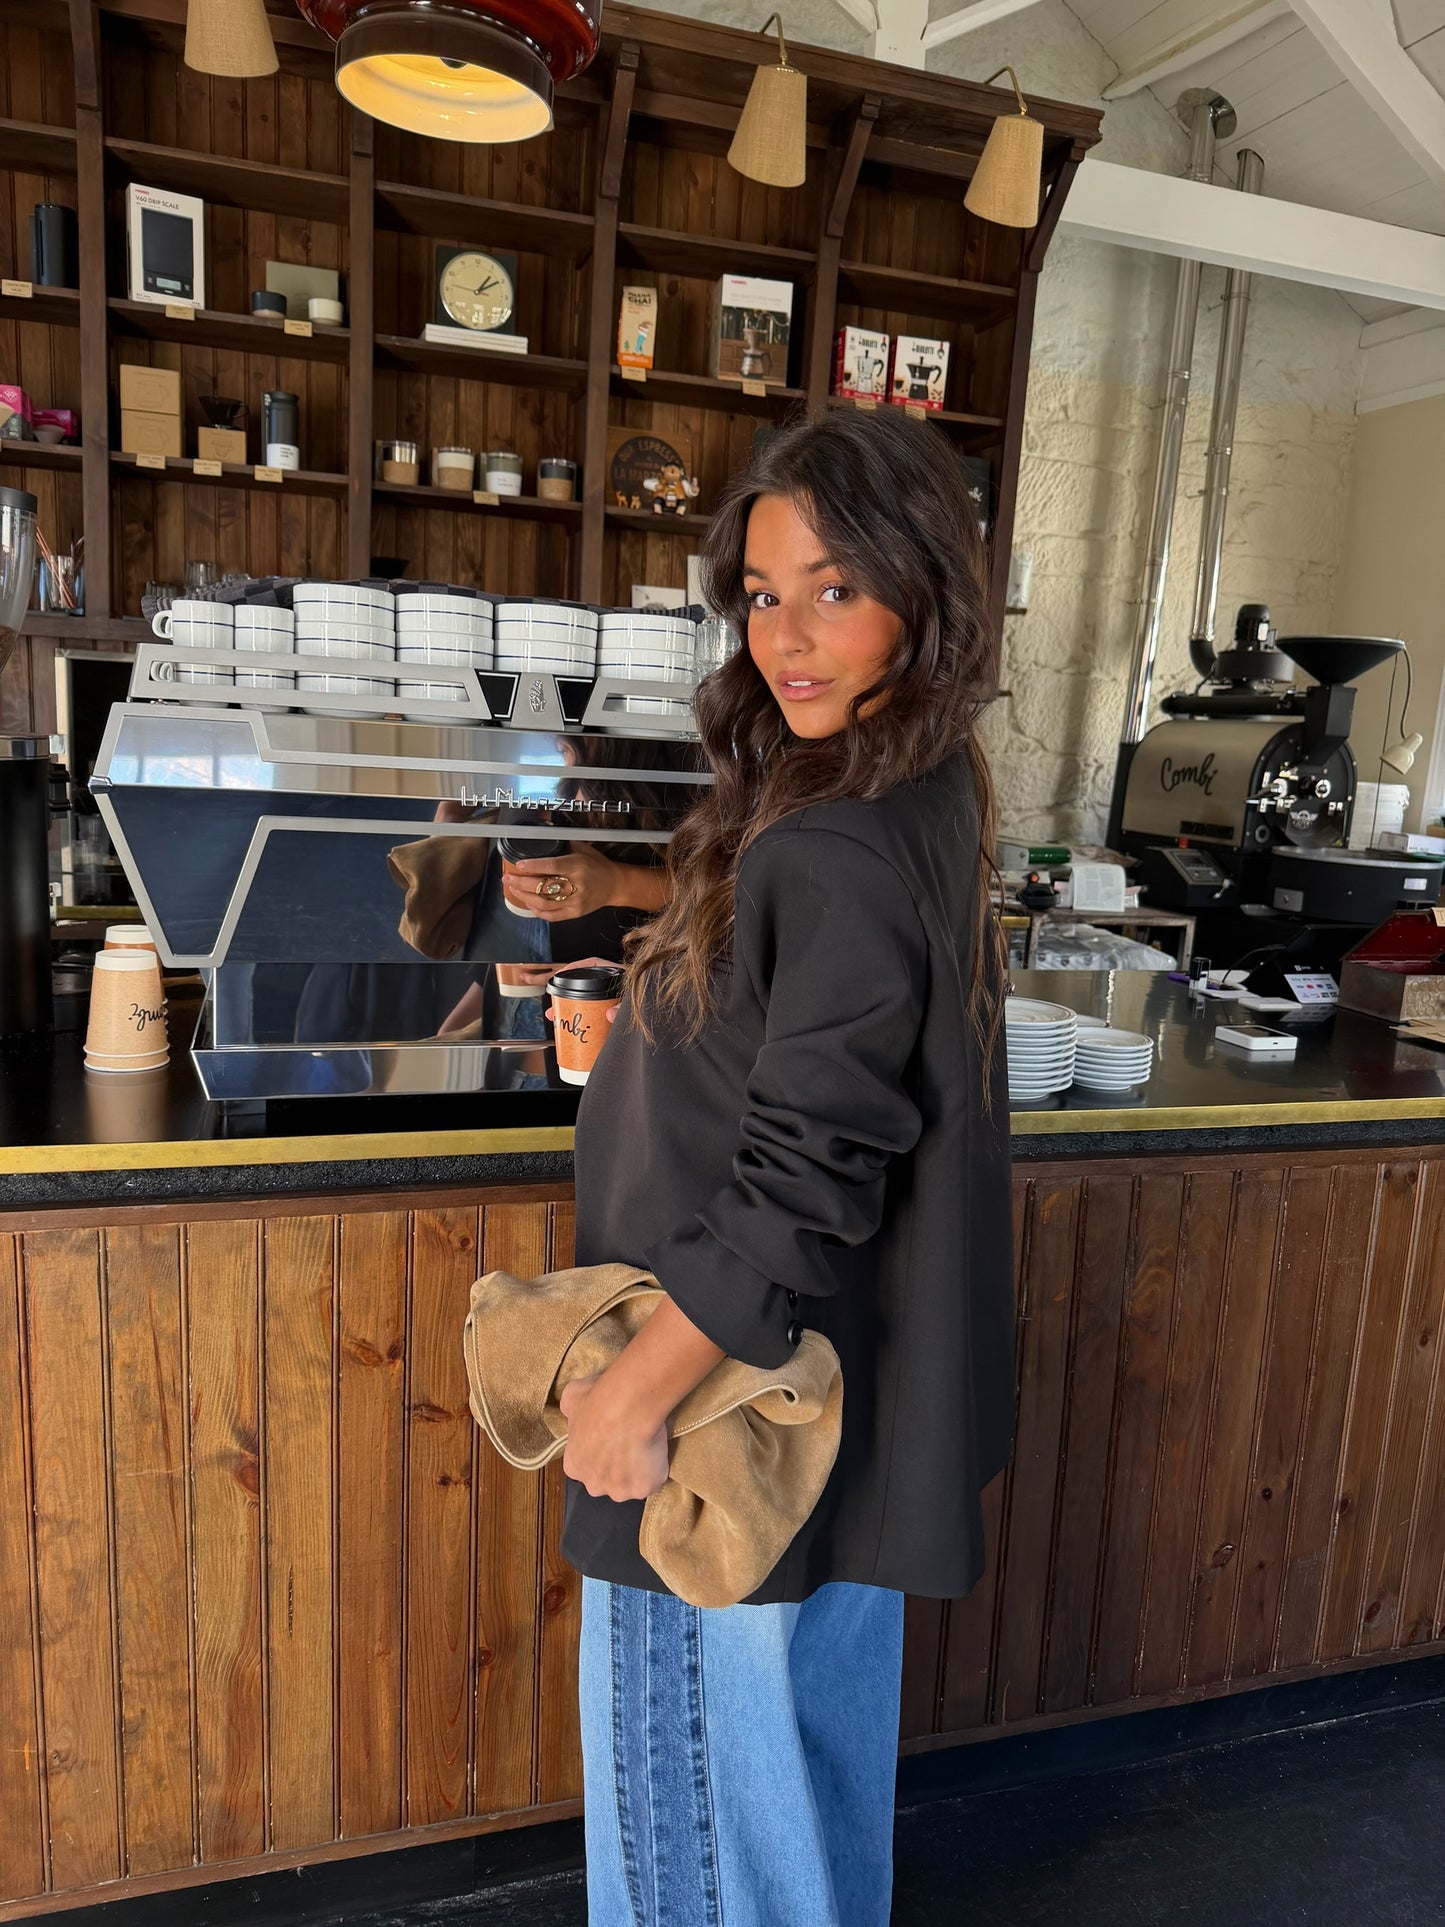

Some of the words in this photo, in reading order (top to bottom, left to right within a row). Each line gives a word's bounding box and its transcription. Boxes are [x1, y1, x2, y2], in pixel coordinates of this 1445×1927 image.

[148, 198, 161, 206] DRIP
[161, 201, 179, 210] SCALE
[628, 296, 651, 305] CHAI
[1161, 752, 1218, 796] Combi
[554, 1012, 591, 1044] mbi
